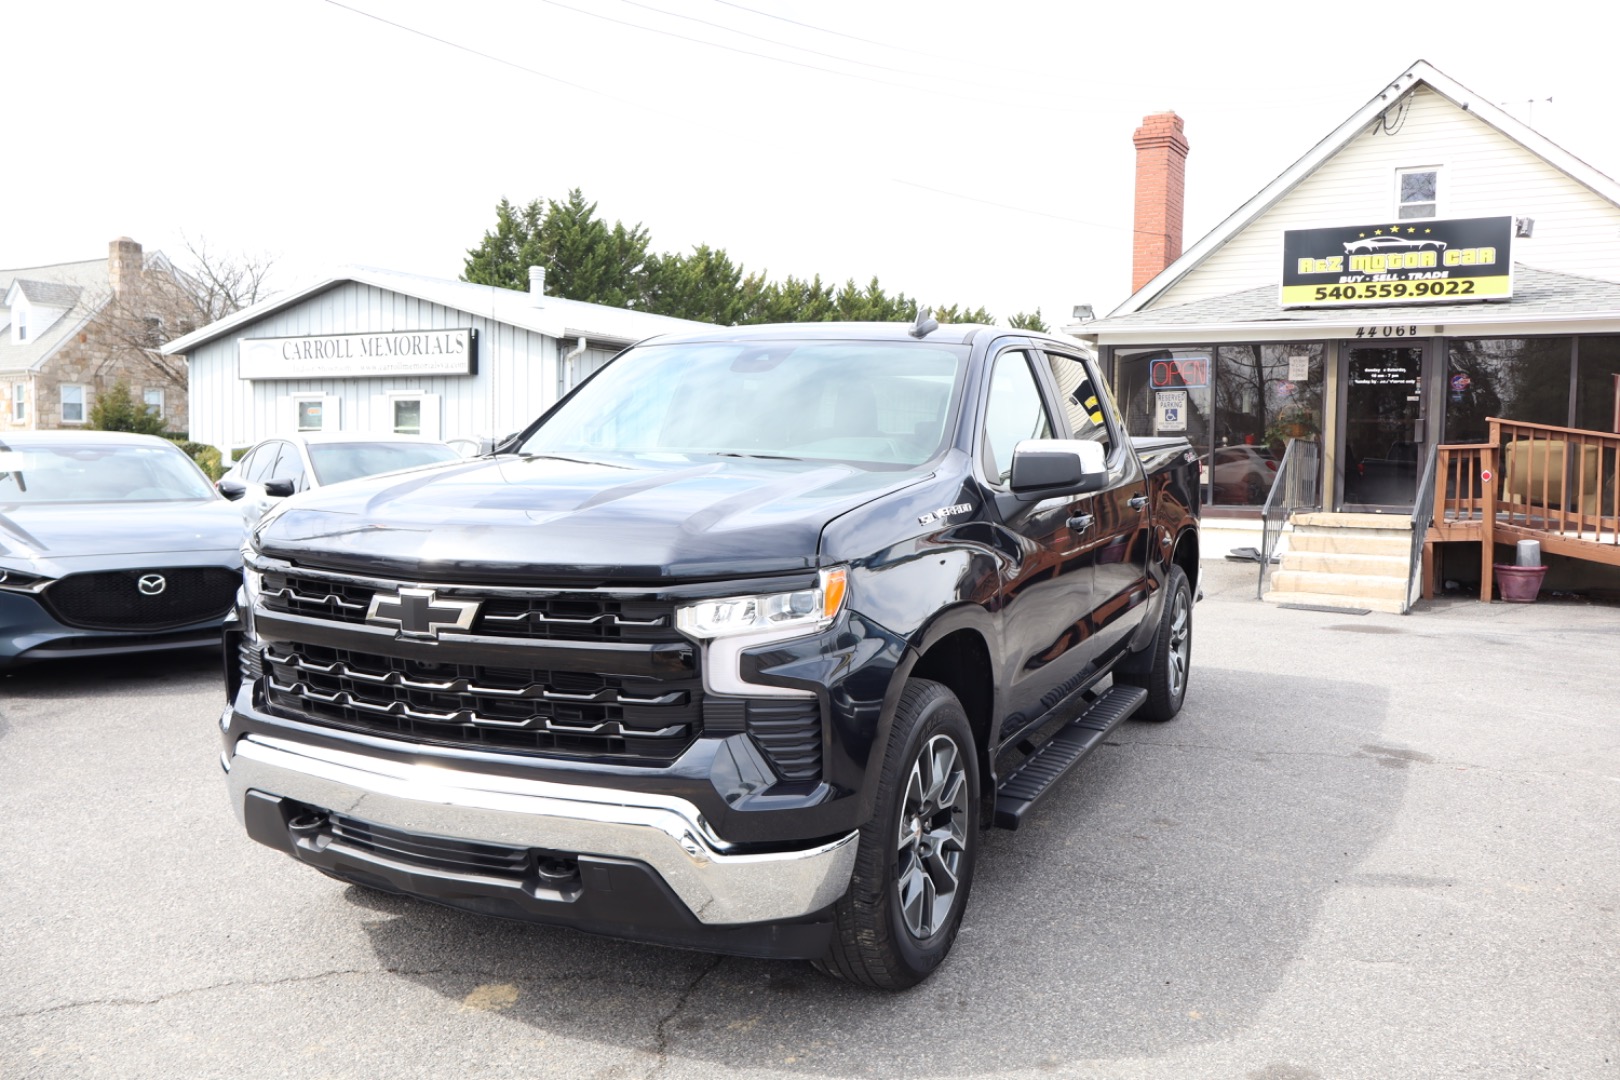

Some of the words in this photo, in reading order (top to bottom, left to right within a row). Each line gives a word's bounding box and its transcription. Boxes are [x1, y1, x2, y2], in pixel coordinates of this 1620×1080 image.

[1339, 275, 1366, 284] BUY
[1372, 273, 1400, 282] SELL
[1408, 271, 1450, 280] TRADE
[1315, 280, 1475, 300] 540.559.9022
[283, 339, 353, 360] CARROLL
[360, 333, 464, 358] MEMORIALS
[1153, 361, 1206, 386] OPEN
[918, 503, 972, 526] SILVERADO
